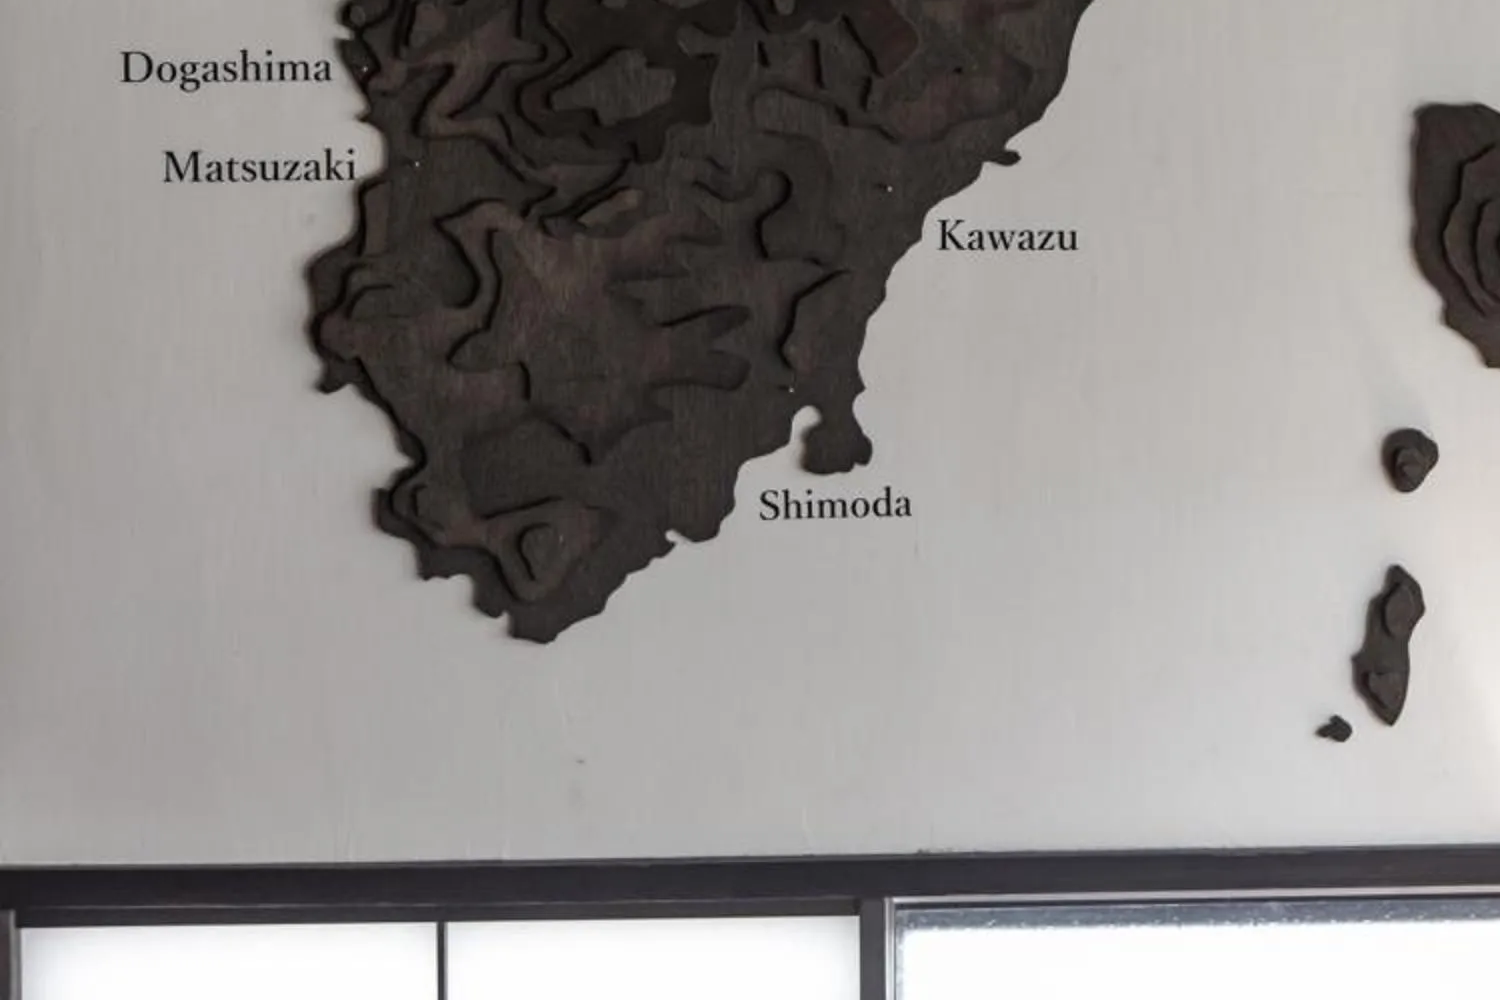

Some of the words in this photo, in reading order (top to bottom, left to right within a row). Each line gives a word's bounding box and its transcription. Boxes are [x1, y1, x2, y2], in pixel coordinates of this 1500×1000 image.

[120, 48, 333, 93] Dogashima
[163, 147, 357, 183] Matsuzaki
[937, 219, 1080, 252] Kawazu
[759, 485, 912, 521] Shimoda
